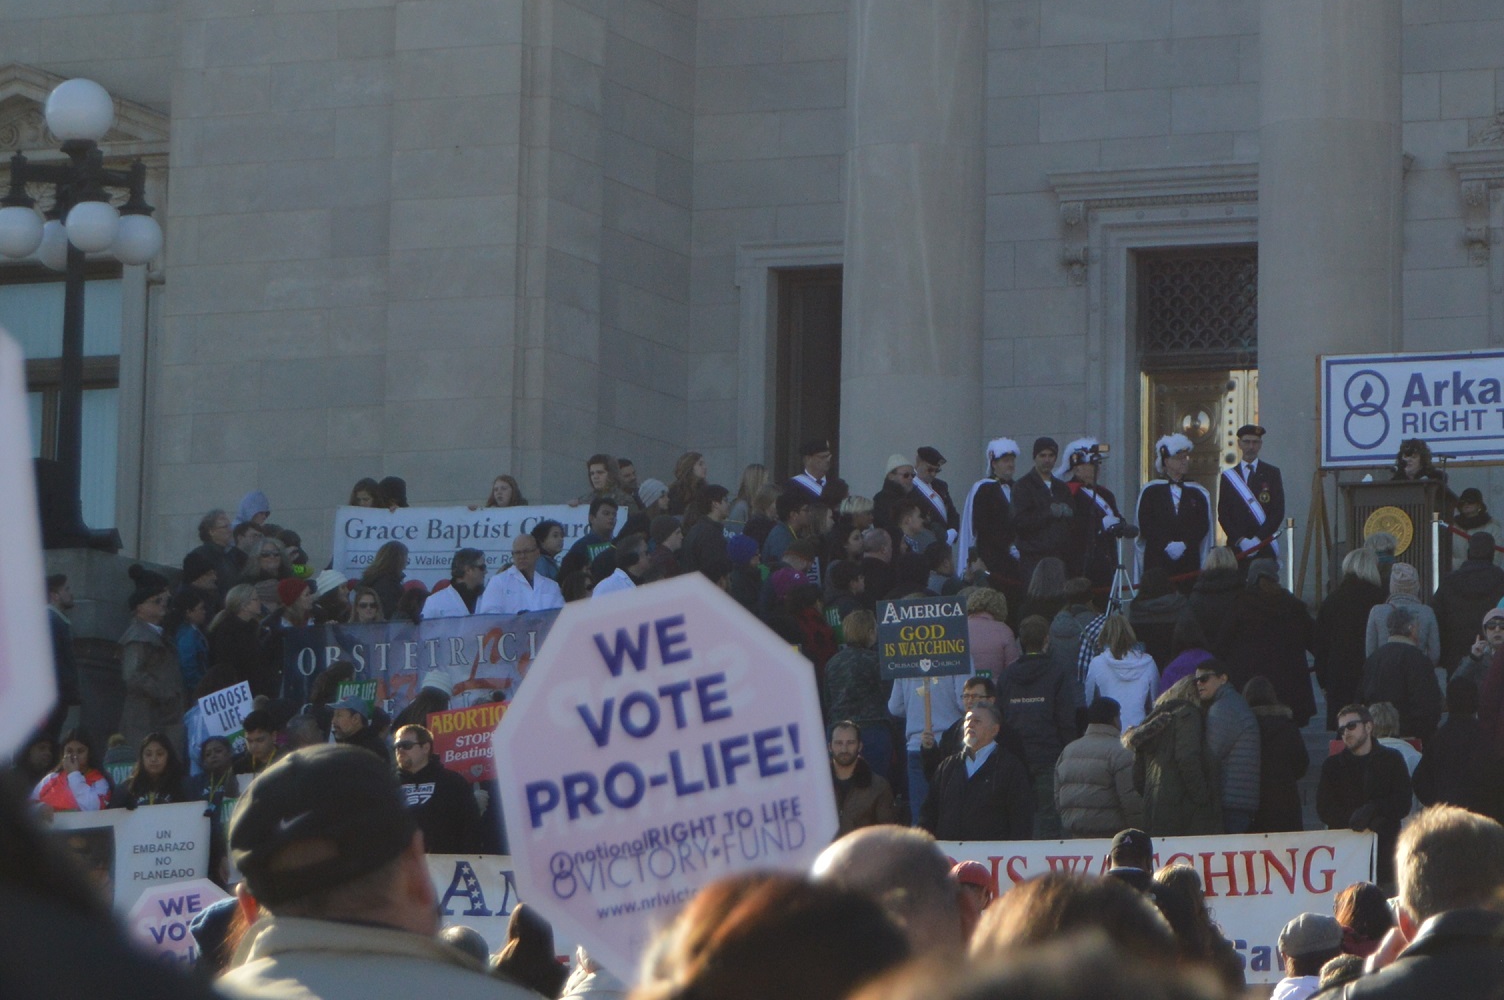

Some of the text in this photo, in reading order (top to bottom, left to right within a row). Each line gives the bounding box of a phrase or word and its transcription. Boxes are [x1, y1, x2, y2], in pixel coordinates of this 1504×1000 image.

[1402, 409, 1487, 434] RIGHT
[345, 517, 418, 540] Grace
[427, 516, 512, 548] Baptist
[881, 602, 964, 624] AMERICA
[900, 624, 945, 641] GOD
[297, 631, 541, 676] OBSTETRICI
[593, 613, 693, 678] WE
[885, 639, 965, 657] IS WATCHING
[203, 685, 249, 716] CHOOSE
[361, 681, 377, 700] LIFE
[430, 705, 508, 735] ABORTIO
[576, 671, 733, 749] VOTE
[444, 746, 494, 763] Beating
[525, 722, 806, 829] PRO-LIFE!
[723, 806, 754, 834] TO
[762, 795, 803, 824] LIFE
[156, 830, 172, 840] UN
[133, 841, 195, 854] EMBARAZO
[155, 857, 172, 866] NO
[133, 868, 195, 881] PLANEADO
[159, 894, 203, 917] WE
